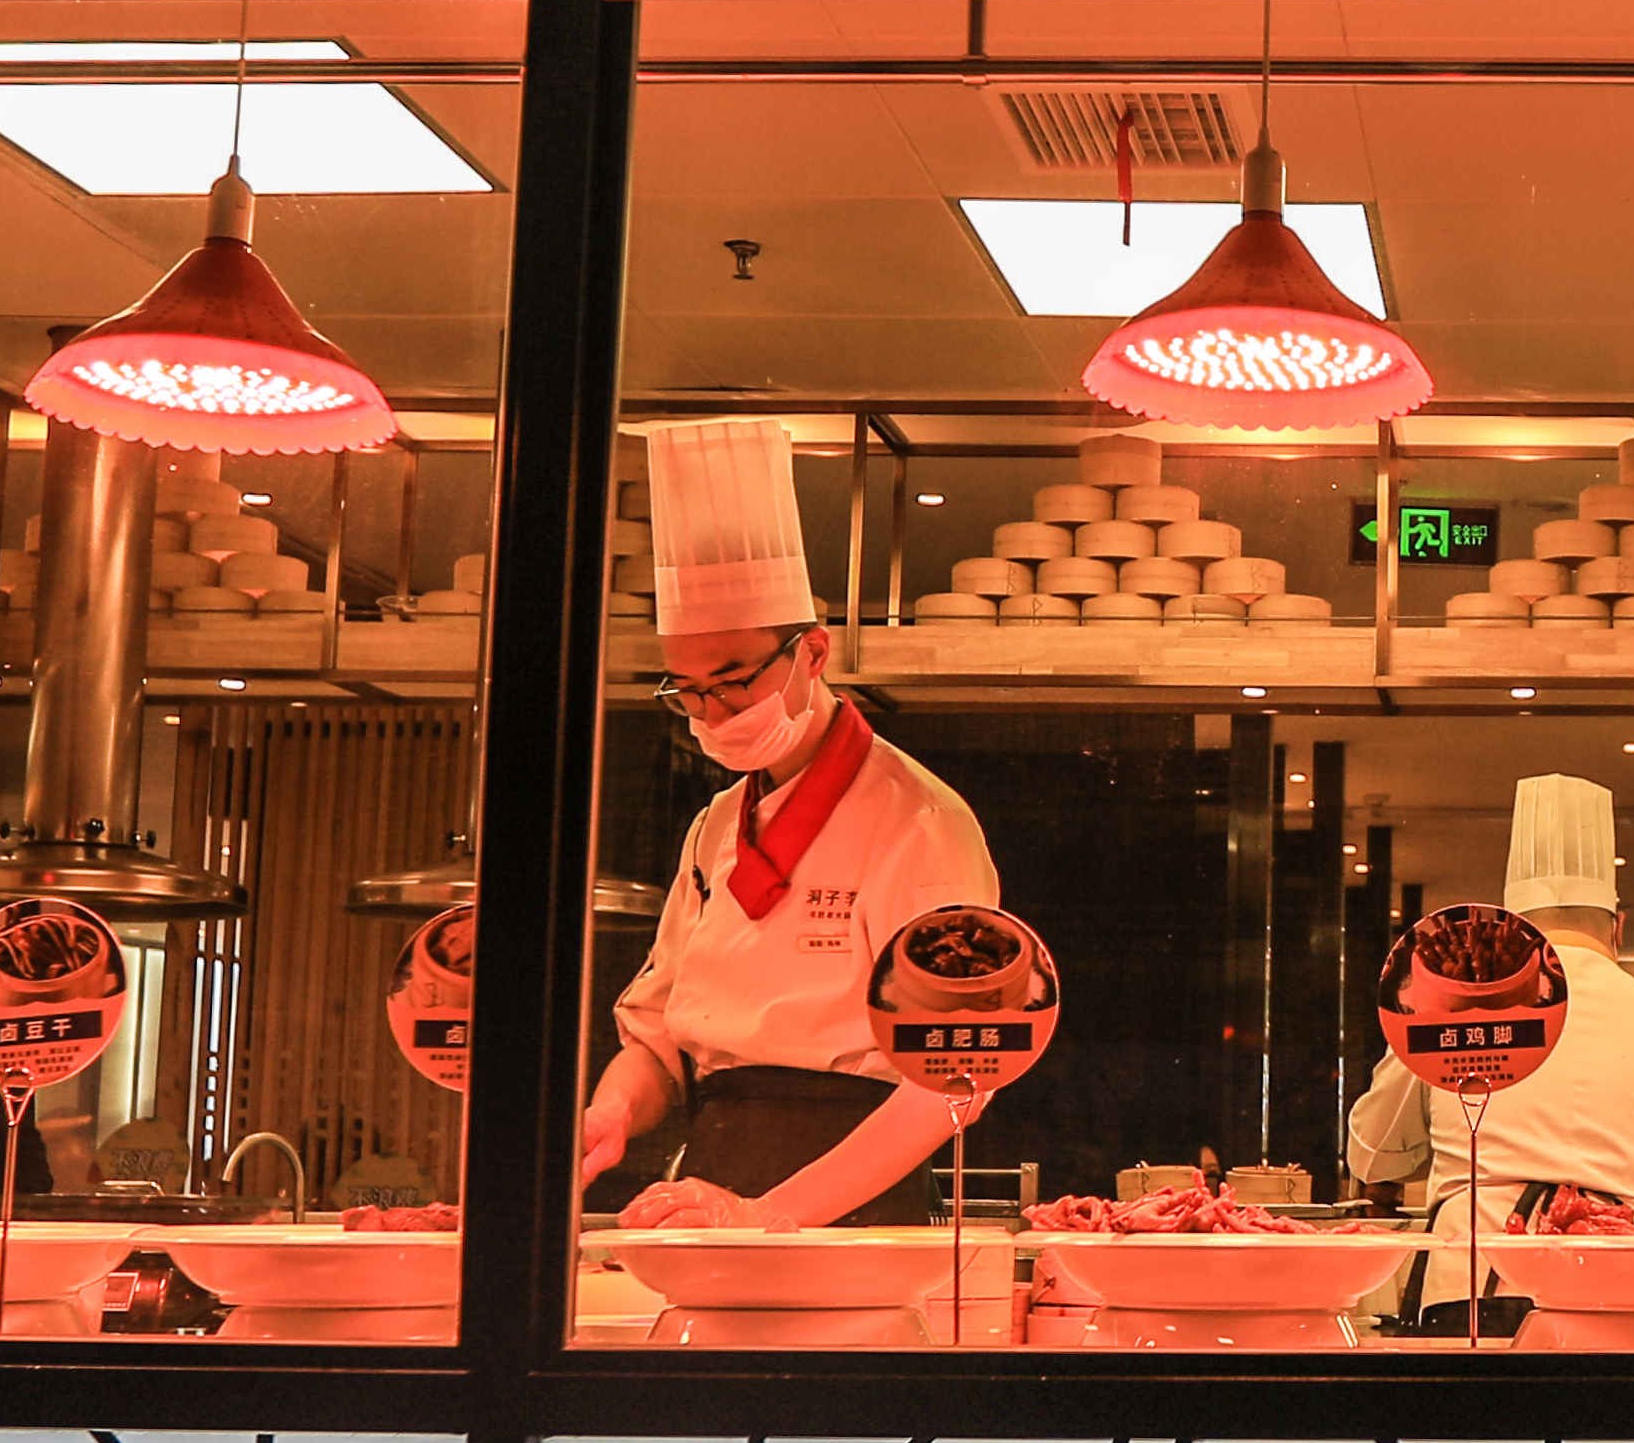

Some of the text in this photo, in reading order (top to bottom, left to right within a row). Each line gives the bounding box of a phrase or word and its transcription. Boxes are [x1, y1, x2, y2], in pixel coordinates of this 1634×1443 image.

[1454, 537, 1483, 545] EXIT
[925, 1028, 1001, 1048] 卤肥肠
[1439, 1025, 1513, 1048] 卤鸡脚
